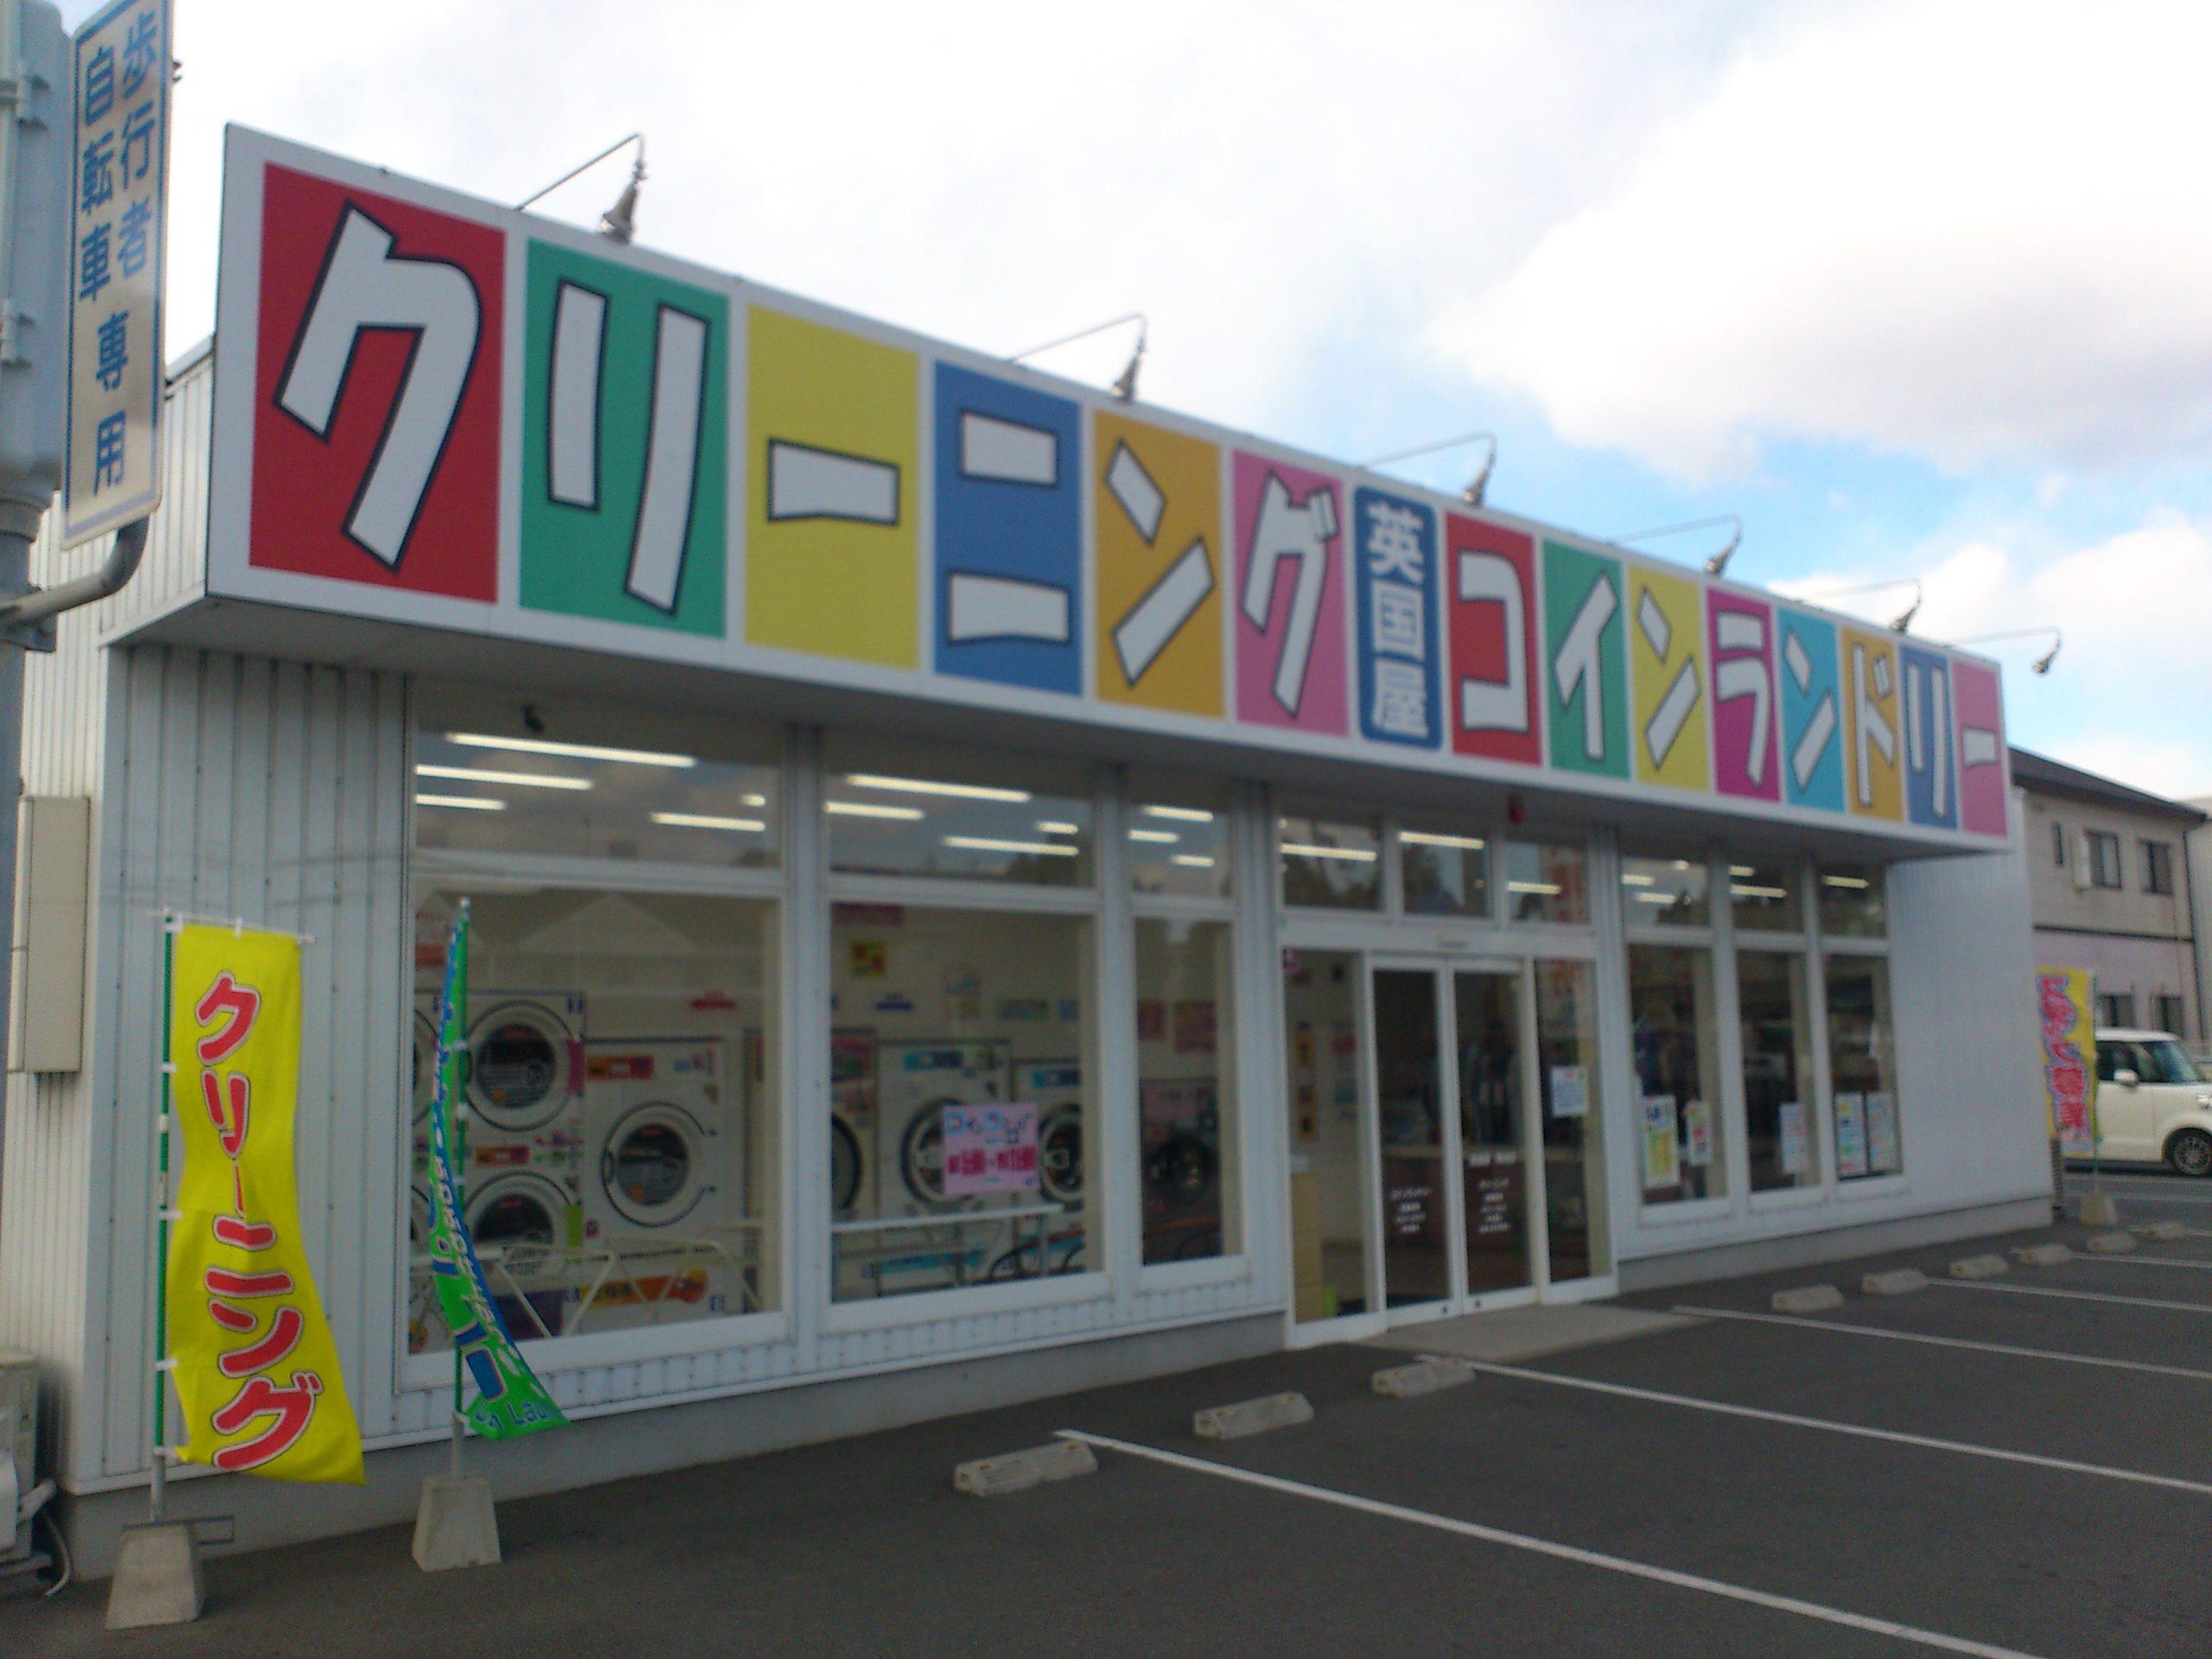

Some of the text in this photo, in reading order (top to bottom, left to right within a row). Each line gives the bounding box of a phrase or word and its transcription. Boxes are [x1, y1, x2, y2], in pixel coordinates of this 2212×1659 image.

[79, 46, 114, 302] 自転車
[118, 10, 157, 281] 歩行者
[92, 311, 129, 497] 専用
[275, 199, 1340, 719] クリーニング
[1367, 501, 1429, 738] 英国屋
[1457, 546, 1999, 819] コインランドリー
[195, 969, 324, 1472] クリーニング
